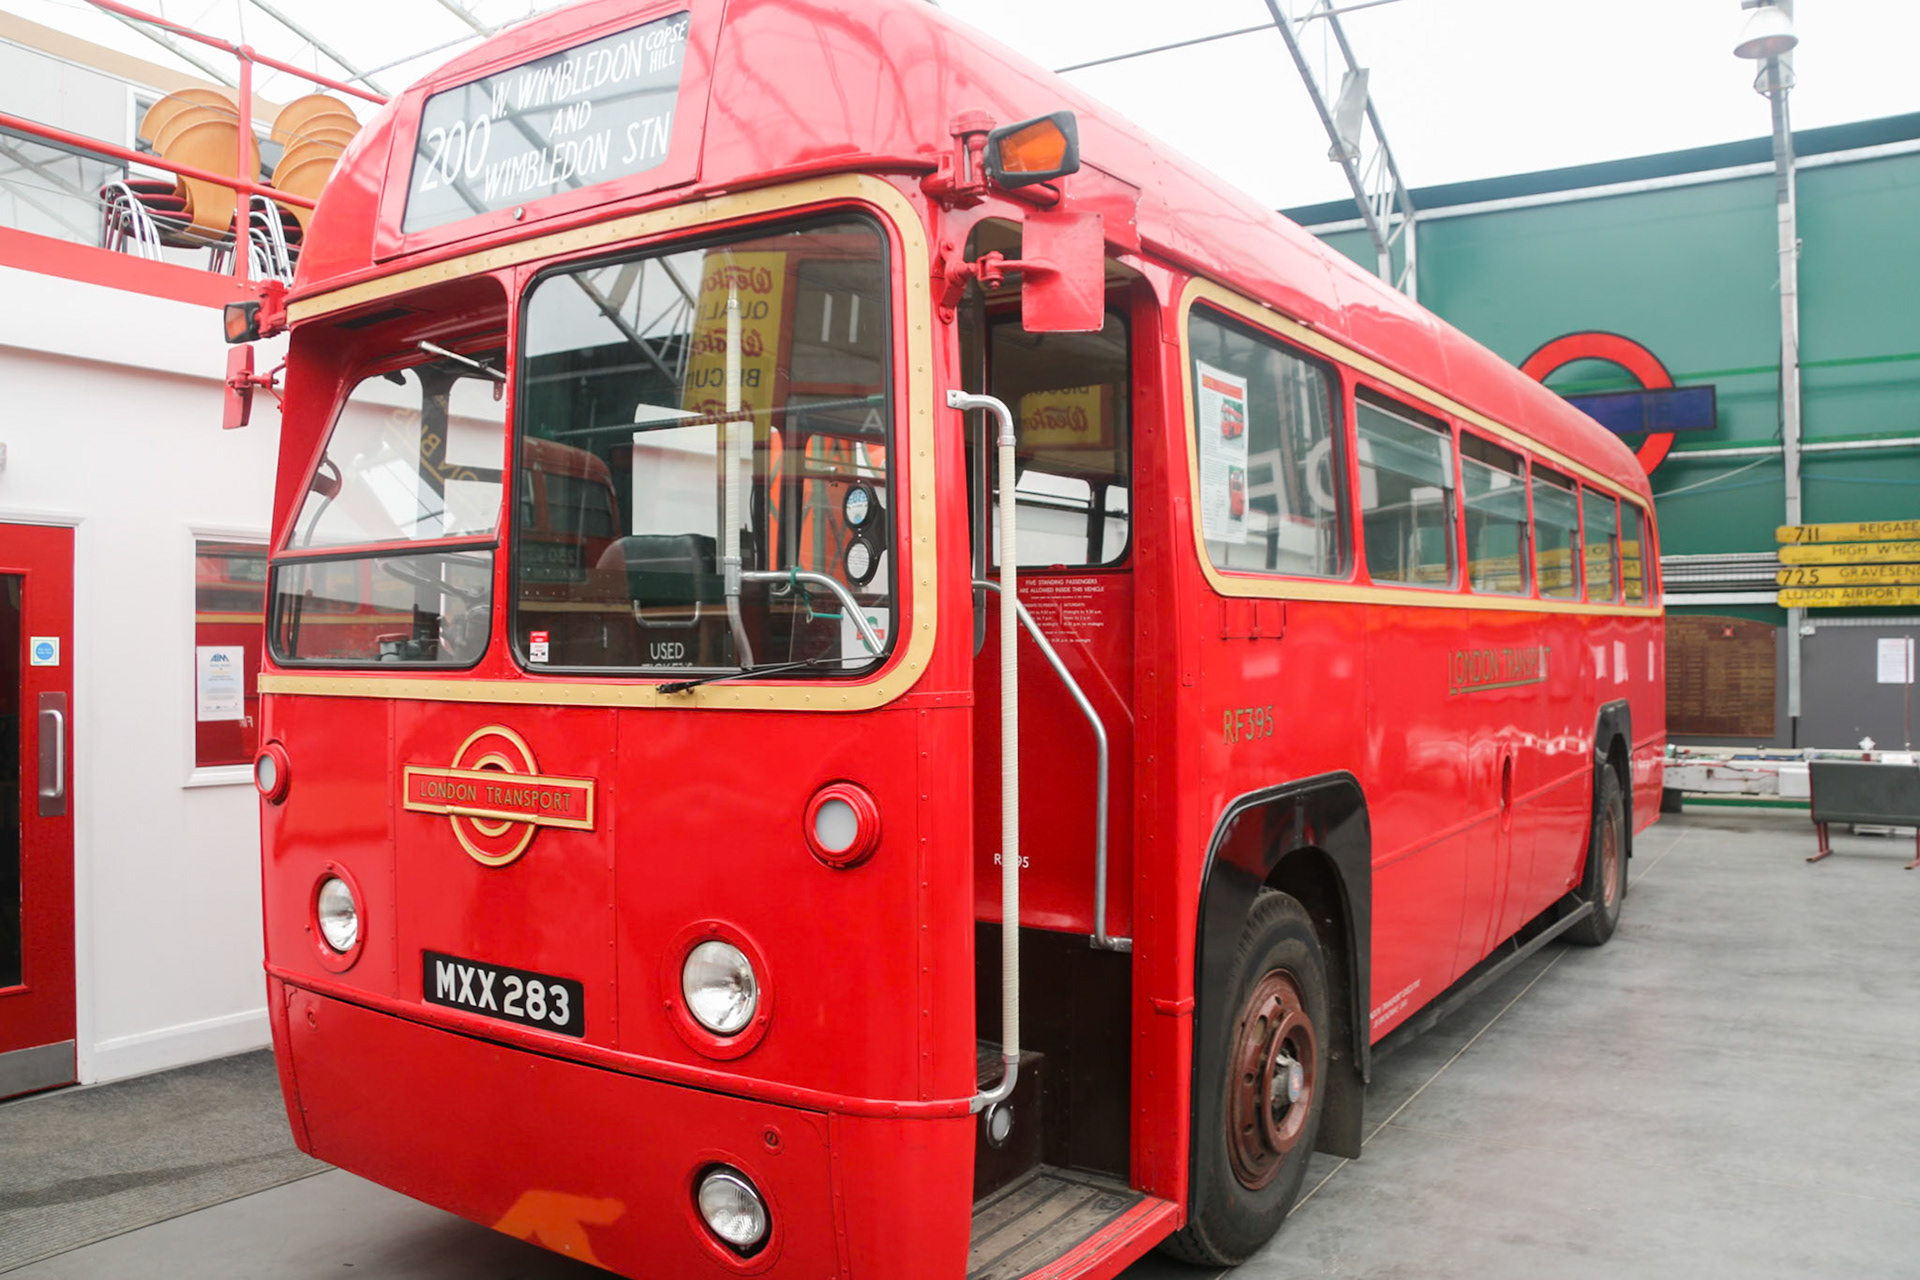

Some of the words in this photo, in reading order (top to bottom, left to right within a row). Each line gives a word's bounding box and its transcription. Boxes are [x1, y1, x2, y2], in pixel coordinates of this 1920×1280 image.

[645, 20, 688, 51] COPSE
[649, 44, 676, 73] HILL
[490, 78, 513, 120] W.
[517, 36, 645, 112] WIMBLEDON
[549, 101, 592, 138] AND
[419, 114, 491, 193] 200
[484, 129, 612, 201] WIMBLEDON
[622, 112, 671, 164] STN
[1794, 527, 1819, 542] 711
[1859, 521, 1920, 534] REIGATE
[1833, 544, 1868, 556] HIGH
[1782, 569, 1820, 585] 725
[1786, 589, 1834, 601] LUTON
[1841, 588, 1903, 599] AIRPORT
[649, 641, 685, 660] USED
[1449, 648, 1500, 695] LONDON
[1502, 646, 1553, 681] TRANSPT
[1223, 704, 1274, 745] RF395
[419, 780, 477, 801] LONDON
[486, 786, 571, 811] TRANSPORT
[993, 853, 1030, 868] R95
[436, 960, 499, 1012] MXX
[502, 975, 571, 1026] 283
